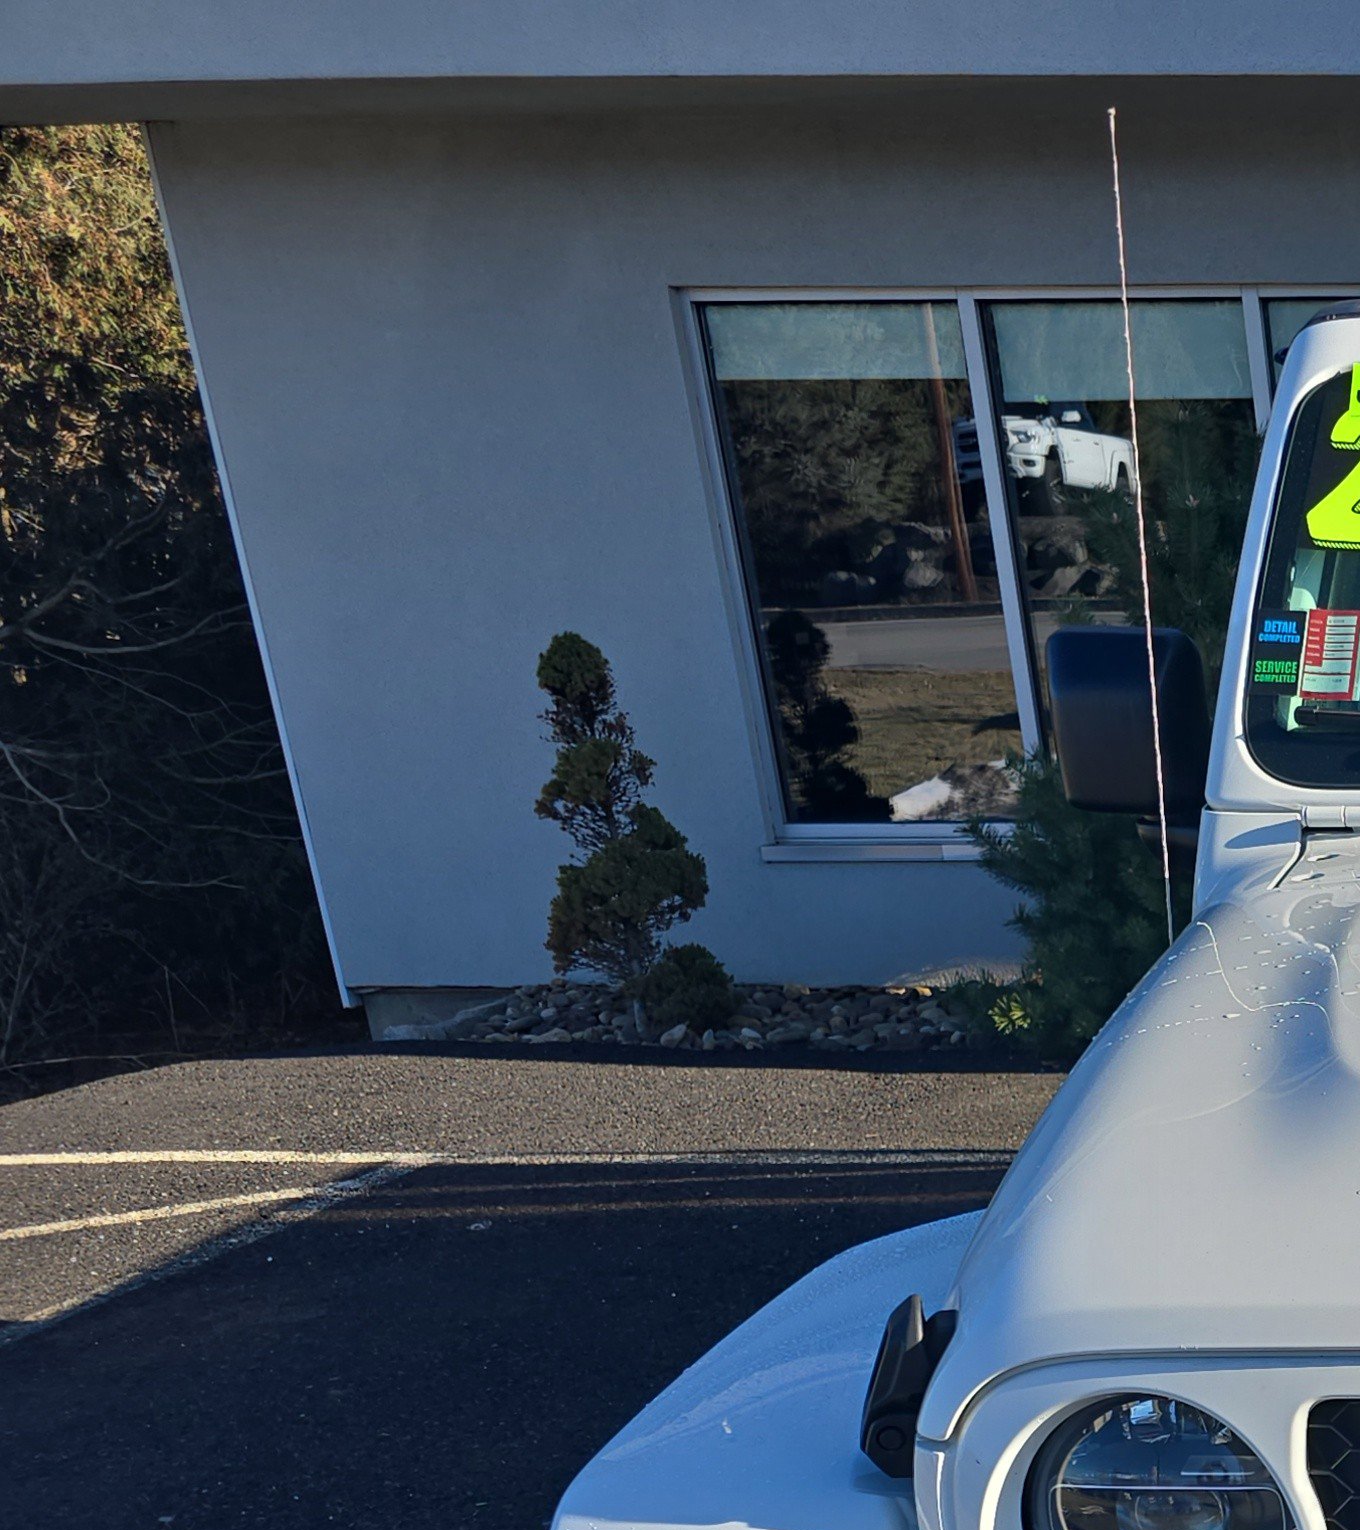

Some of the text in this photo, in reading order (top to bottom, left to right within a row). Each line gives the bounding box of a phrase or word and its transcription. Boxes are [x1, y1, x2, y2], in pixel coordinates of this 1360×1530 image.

[1264, 619, 1297, 634] DETAIL
[1258, 633, 1300, 643] COMPLETED
[1255, 660, 1297, 674] SERVICE
[1254, 674, 1297, 683] COMPLETED
